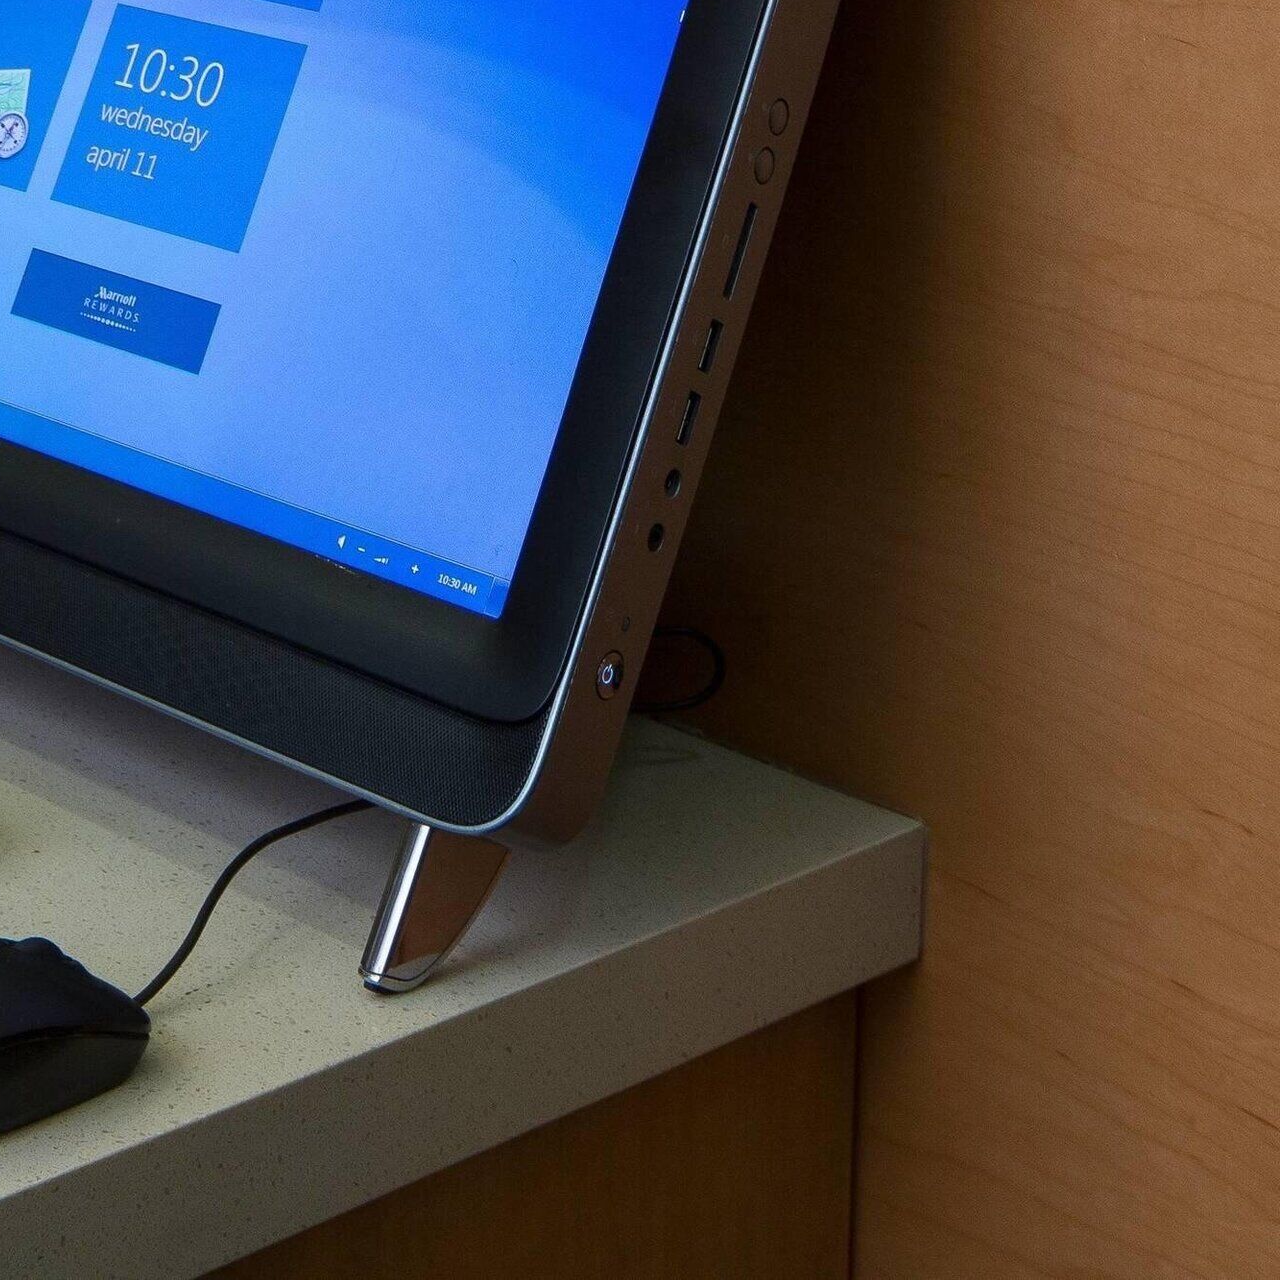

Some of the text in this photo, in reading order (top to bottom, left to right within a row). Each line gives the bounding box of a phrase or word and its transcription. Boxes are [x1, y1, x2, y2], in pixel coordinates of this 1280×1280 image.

[114, 42, 225, 107] 10:30
[101, 102, 209, 152] wednesday
[86, 144, 159, 181] april 11
[83, 297, 140, 323] REWARDS
[93, 285, 137, 308] Marriott
[437, 573, 478, 596] 10:30 AM
